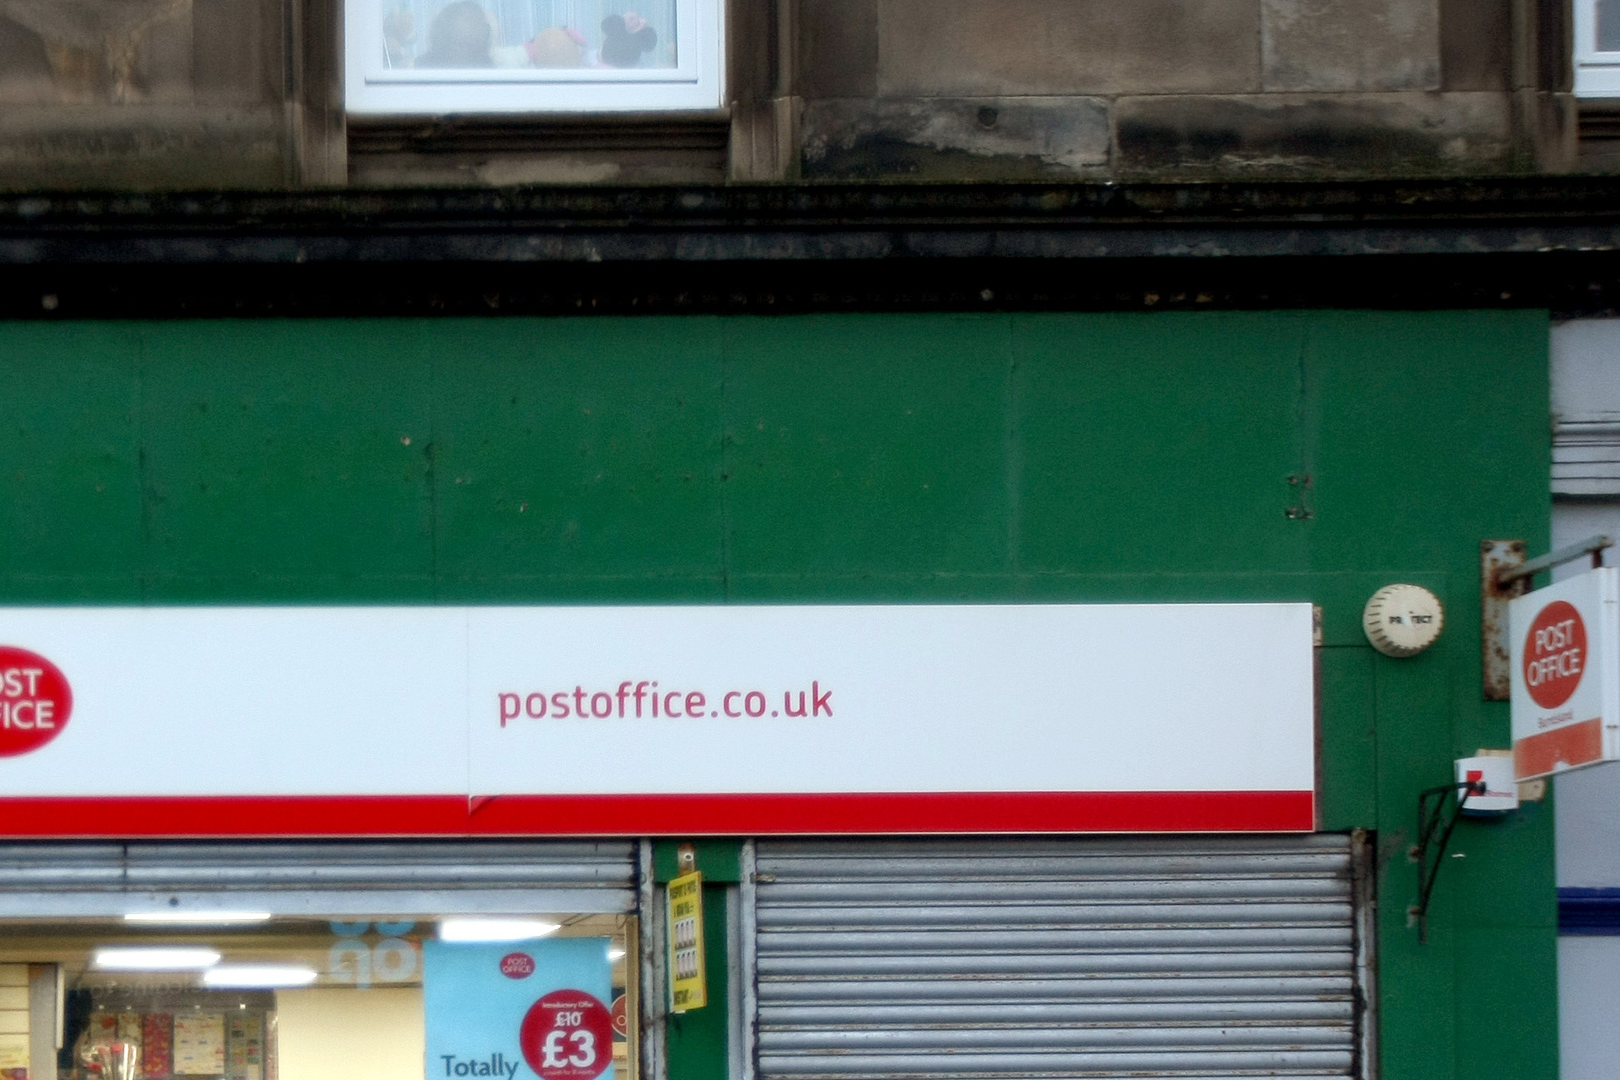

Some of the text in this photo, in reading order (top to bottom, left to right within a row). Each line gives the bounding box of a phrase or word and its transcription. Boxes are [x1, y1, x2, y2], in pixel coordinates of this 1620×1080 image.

[1388, 614, 1434, 625] PRTECT
[1535, 618, 1576, 655] POST
[1527, 647, 1582, 687] OFFICE
[498, 680, 834, 729] postoffice.co.uk
[502, 965, 531, 973] OFFICE
[507, 957, 529, 966] POST
[542, 1030, 597, 1068] £3
